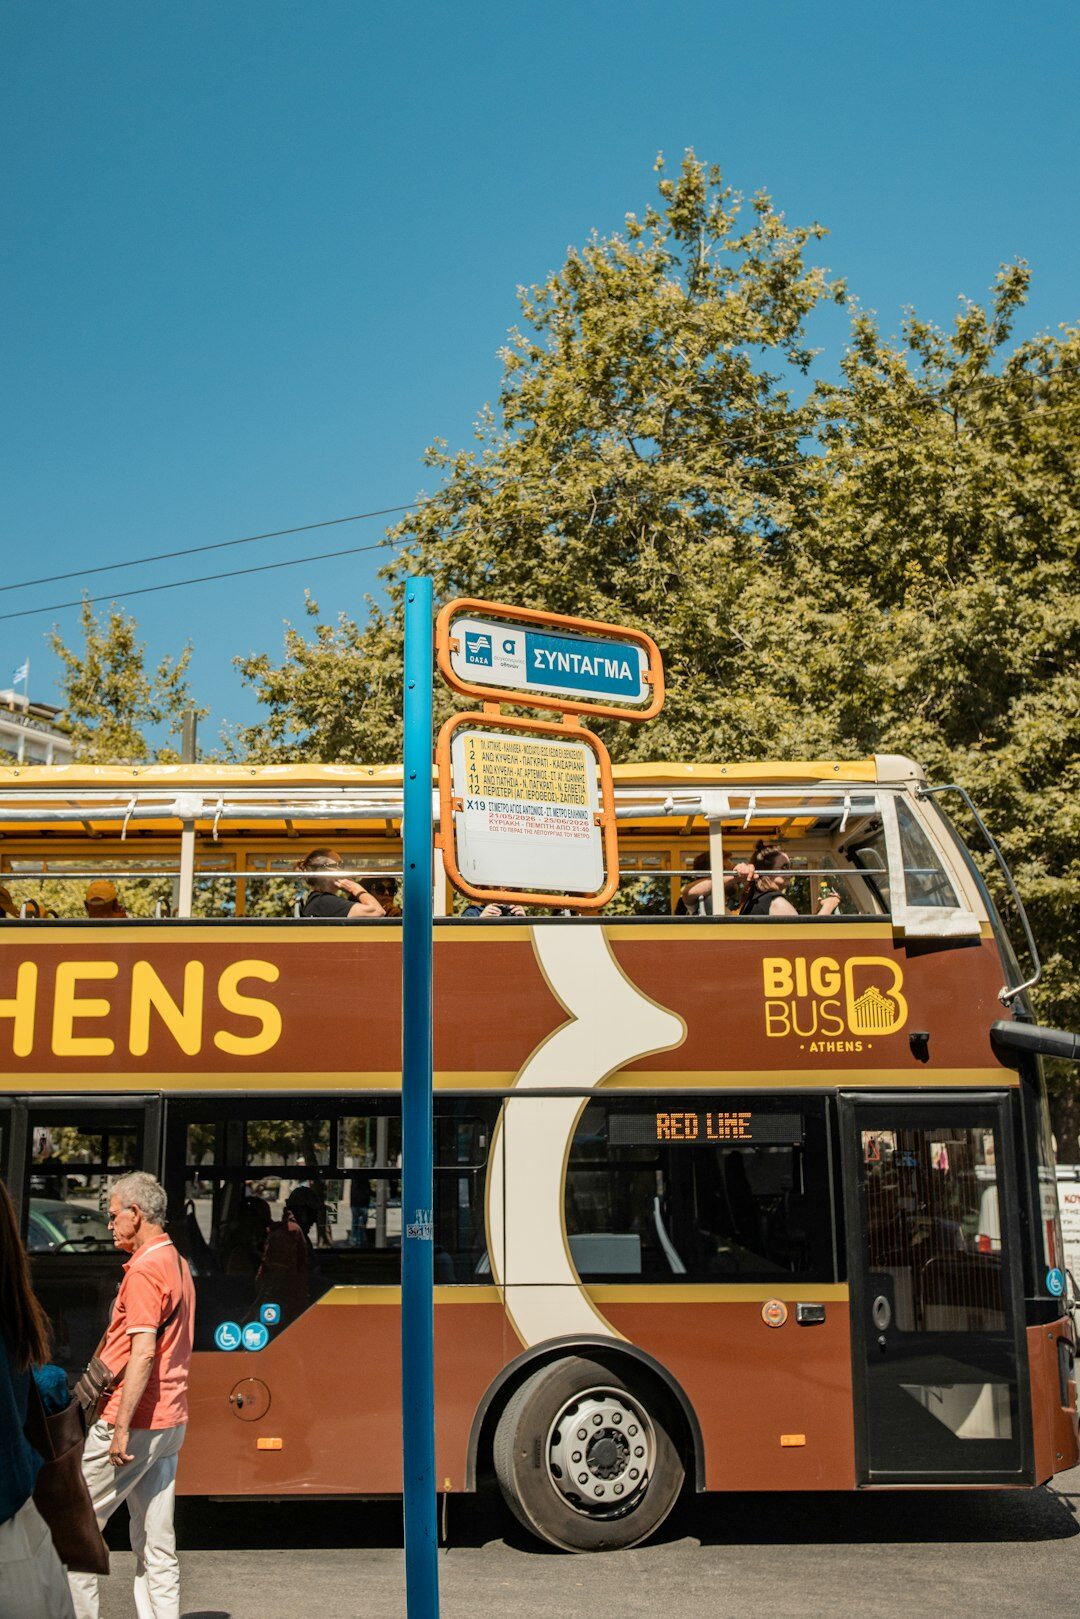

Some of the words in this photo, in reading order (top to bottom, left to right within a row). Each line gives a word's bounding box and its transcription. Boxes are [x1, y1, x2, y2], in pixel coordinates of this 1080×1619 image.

[469, 656, 489, 665] ΟΑΣΑ
[533, 648, 633, 681] ΣΥΝΤΑΓΜΑ
[469, 739, 475, 749] 1
[469, 750, 475, 760] 2
[482, 752, 495, 762] ΑΝΩ
[495, 753, 519, 764] ΚΥΨΕΛΗ
[522, 756, 549, 768] ΠΑΓΚΡΑΤΙ
[553, 759, 585, 771] ΚΑΙΣΑΡΙΑΝΗ
[470, 763, 477, 772] 4
[482, 764, 493, 774] ΑΝΩ
[493, 766, 514, 776] ΚΥΨΕΛΗ
[469, 774, 479, 784] 11
[483, 775, 495, 785] ΑΝΩ
[496, 776, 519, 787] ΠΑΤΗΣΙΑ
[529, 780, 554, 791] ΠΑΓΚΡΑΤΙ
[564, 783, 586, 794] ΕΛΒΕΤΙΑ
[466, 799, 486, 811] X19
[469, 785, 480, 795] 12
[483, 786, 513, 798] ΠΕΡΙΣΤΕΡΙ
[560, 793, 585, 805] ΖΑΠΠΕΙΟ
[488, 819, 520, 827] ΚΥΡΙΑΚΗ
[525, 822, 554, 830] ΠΕΜΠΤΗ
[762, 956, 842, 998] BIG
[765, 1000, 845, 1037] BUS
[809, 1041, 863, 1052] ATHENS
[656, 1112, 699, 1140] RED
